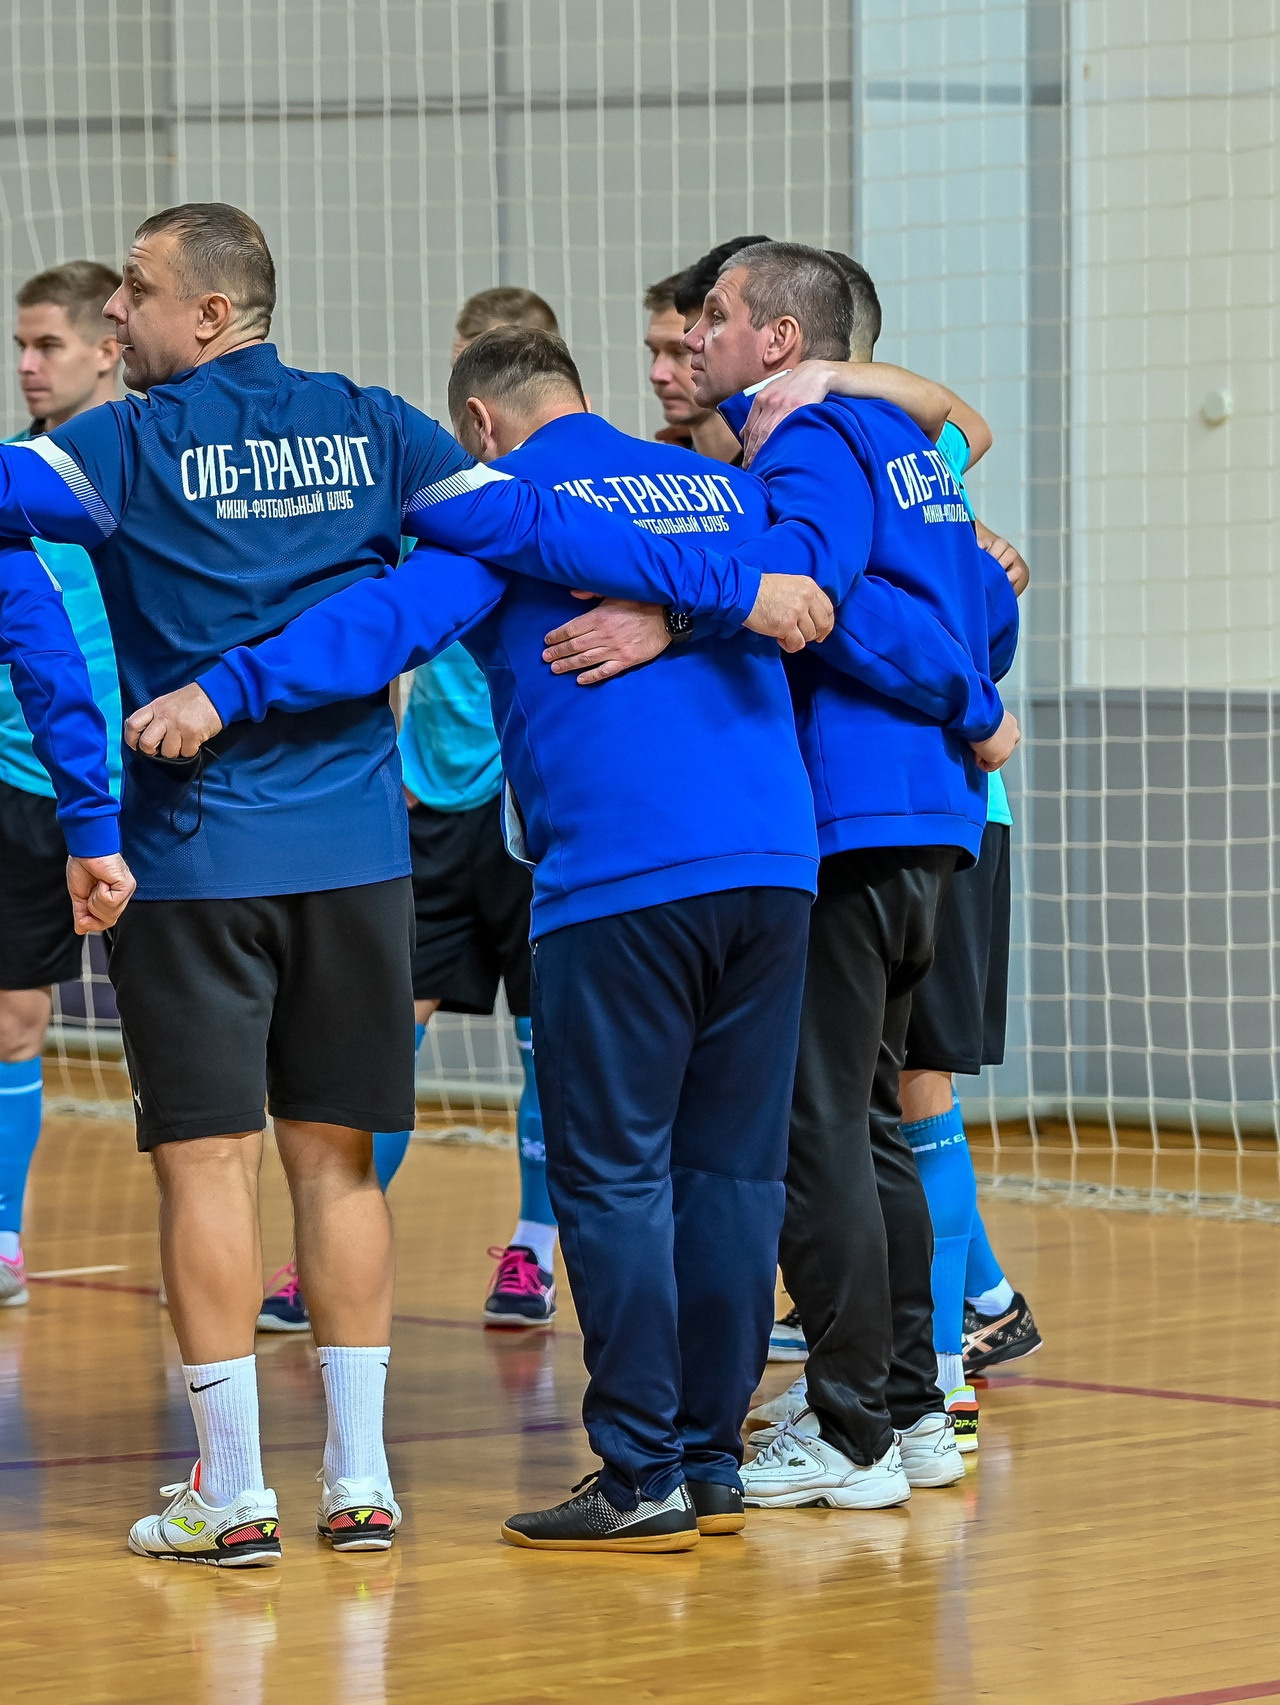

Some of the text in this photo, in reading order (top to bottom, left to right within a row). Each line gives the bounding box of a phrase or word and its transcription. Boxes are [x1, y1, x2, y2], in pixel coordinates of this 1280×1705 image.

[180, 434, 376, 501] СИБ-ТРАНЗИТ
[216, 489, 355, 520] МИНИ-ФУТБОЛЬНЫЙ КЛУБ
[702, 514, 730, 533] КЛУБ
